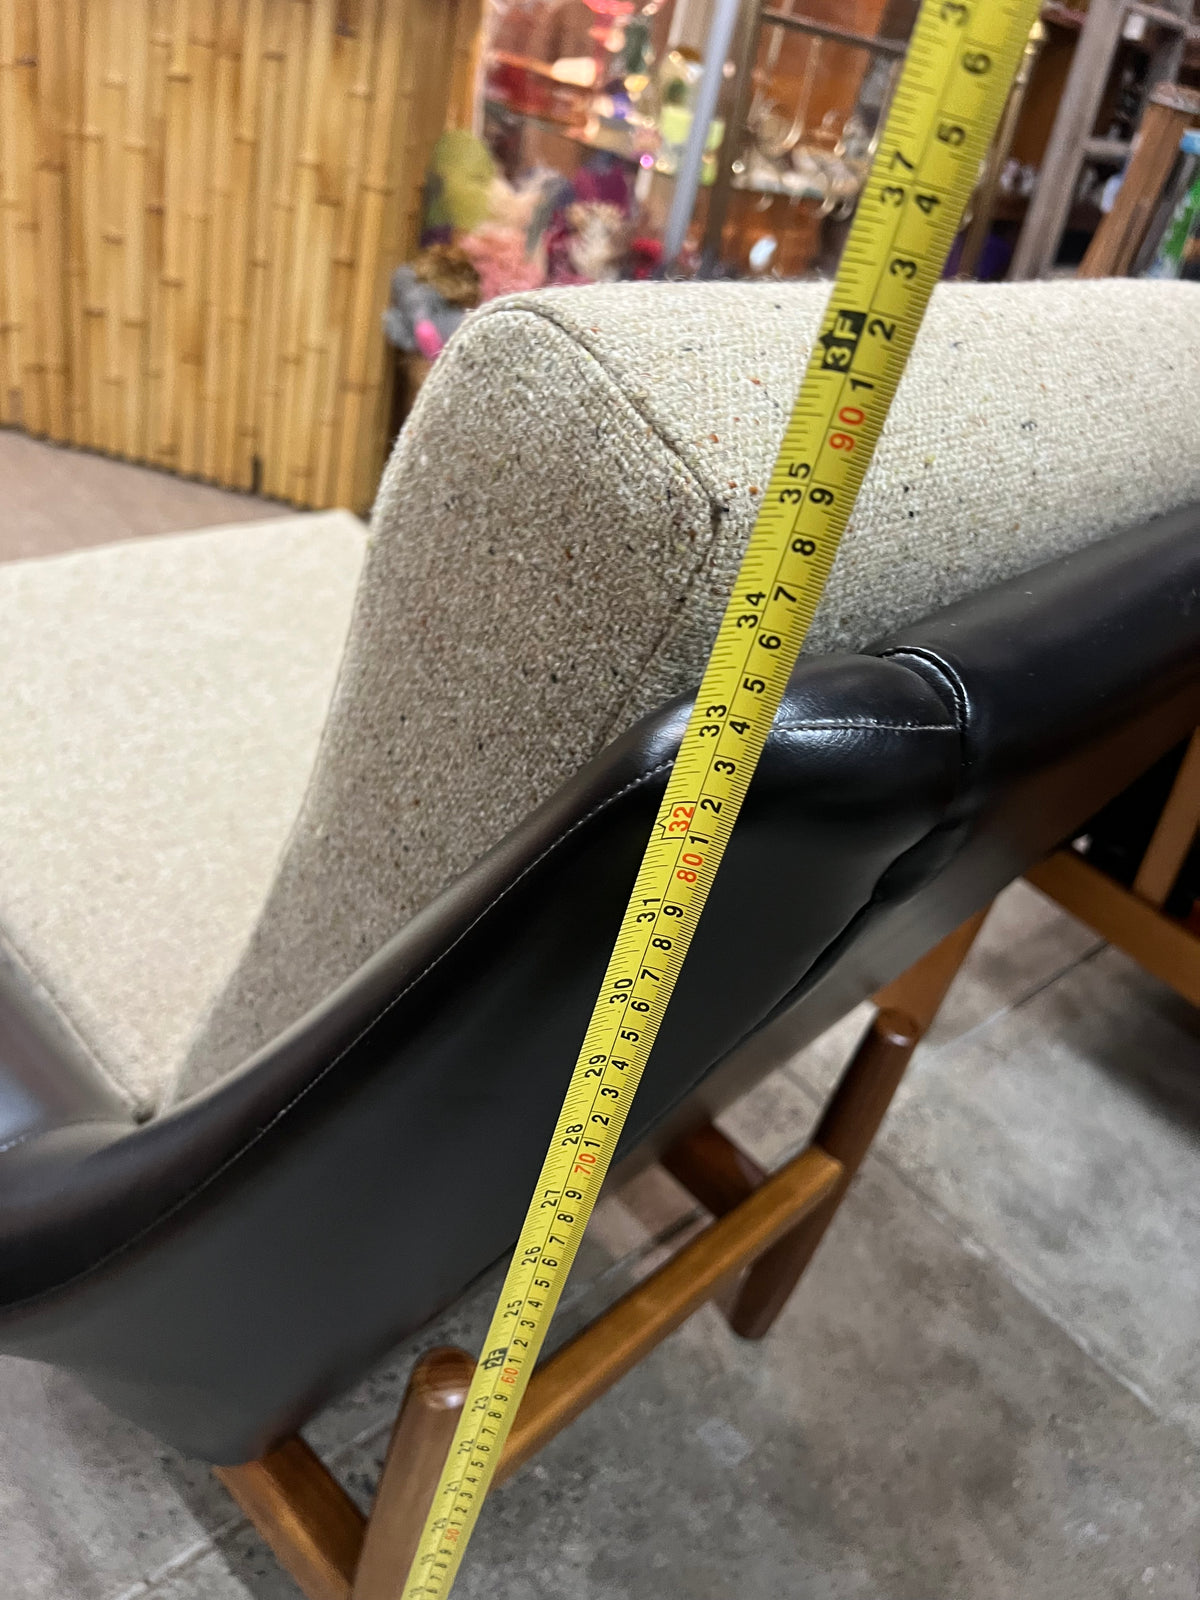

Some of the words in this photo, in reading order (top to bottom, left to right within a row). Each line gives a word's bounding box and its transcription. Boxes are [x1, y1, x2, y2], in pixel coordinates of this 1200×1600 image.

[962, 52, 992, 75] 6
[937, 123, 966, 146] 5
[880, 150, 915, 208] 37
[915, 193, 942, 214] 4
[890, 258, 917, 280] 3
[868, 319, 896, 341] 2
[851, 379, 874, 391] 1
[829, 407, 865, 452] 90
[779, 462, 811, 505] 35
[809, 488, 834, 505] 9
[792, 539, 816, 556] 8
[774, 586, 797, 602] 7
[737, 592, 766, 628] 34
[758, 634, 781, 649] 6
[743, 678, 765, 693] 5
[699, 705, 727, 737] 33
[730, 721, 750, 735] 4
[714, 760, 735, 775] 3
[700, 799, 722, 814] 2
[669, 807, 694, 832] 32
[689, 836, 709, 844] 1
[676, 853, 703, 882] 80
[636, 898, 661, 923] 31
[663, 906, 683, 918] 9
[652, 938, 672, 950] 8
[640, 969, 660, 981] 7
[610, 979, 633, 1003] 30
[631, 1001, 649, 1012] 6
[621, 1031, 639, 1042] 5
[585, 1055, 607, 1078] 29
[611, 1060, 629, 1070] 4
[601, 1088, 619, 1098] 3
[592, 1115, 609, 1126] 2
[562, 1124, 583, 1146] 28
[574, 1154, 596, 1174] 70
[541, 1190, 560, 1208] 27
[565, 1191, 582, 1199] 9
[557, 1214, 573, 1223] 8
[549, 1236, 565, 1245] 7
[521, 1247, 541, 1265] 26
[542, 1258, 557, 1267] 6
[535, 1279, 550, 1288] 5
[504, 1300, 522, 1318] 25
[528, 1300, 542, 1308] 4
[520, 1320, 535, 1328] 3
[514, 1340, 528, 1348] 2
[501, 1368, 518, 1384] 60
